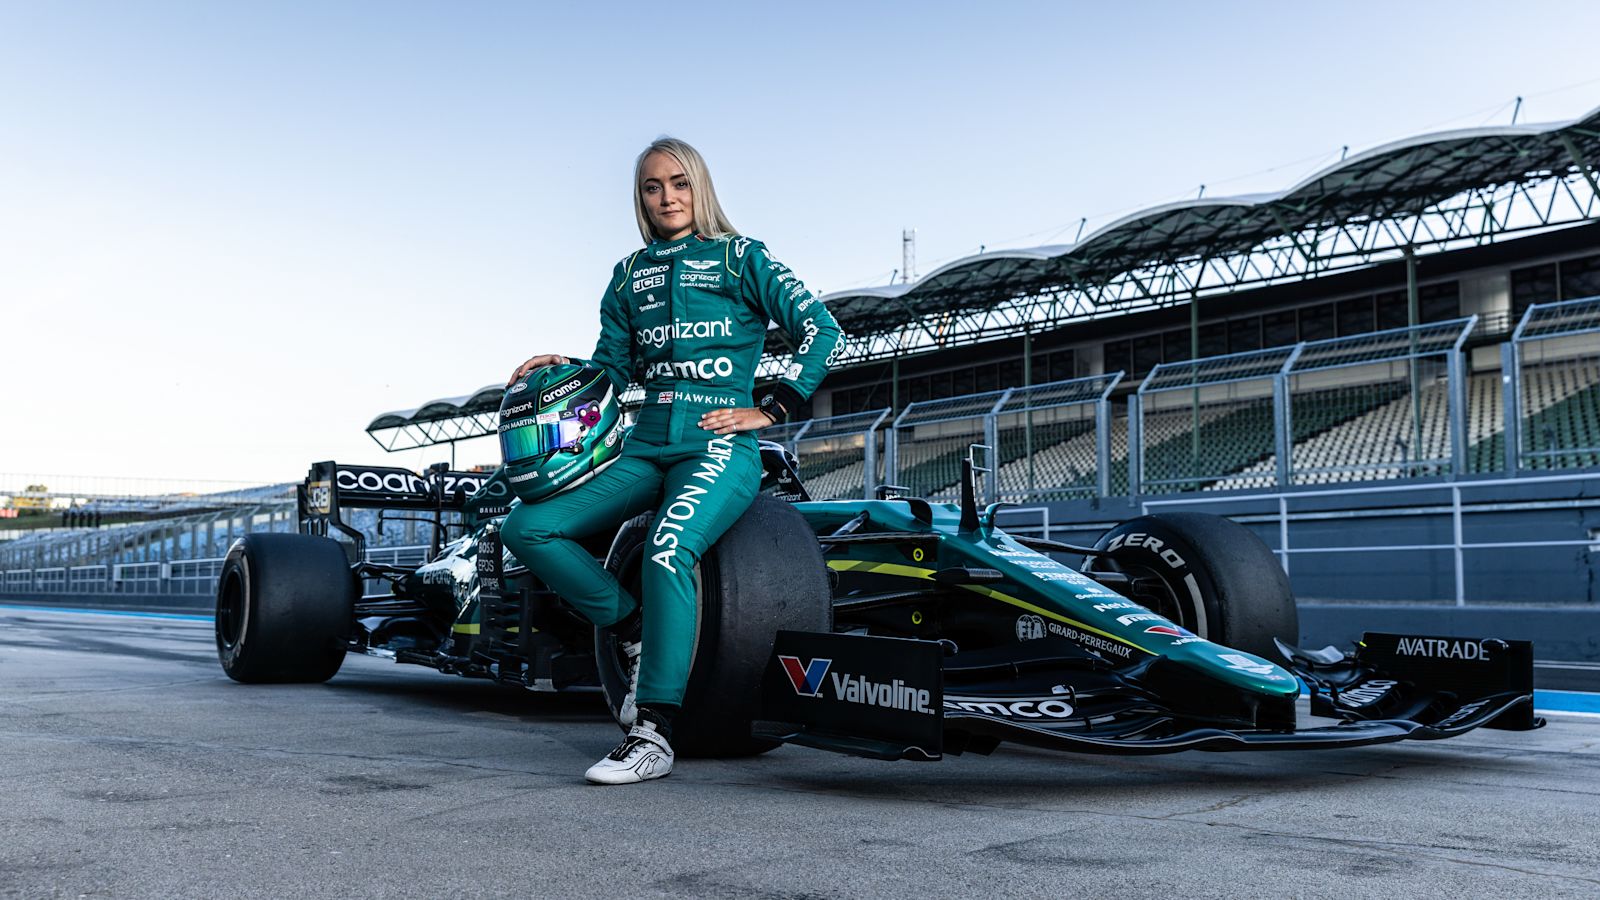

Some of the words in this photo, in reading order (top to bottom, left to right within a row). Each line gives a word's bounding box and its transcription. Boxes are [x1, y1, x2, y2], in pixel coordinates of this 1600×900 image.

[656, 243, 687, 256] cognizant
[633, 265, 669, 278] aramco
[680, 273, 721, 282] cognizant
[634, 276, 663, 291] JCB
[637, 316, 732, 348] cognizant
[543, 380, 581, 402] aramco
[675, 392, 735, 406] HAWKINS
[511, 417, 536, 429] MARTIN
[651, 485, 709, 574] ASTON
[479, 542, 494, 553] BOSS
[1107, 533, 1186, 569] ZERO
[1048, 622, 1132, 659] GIRARD-PERREGAUX
[1396, 637, 1491, 661] AVATRADE
